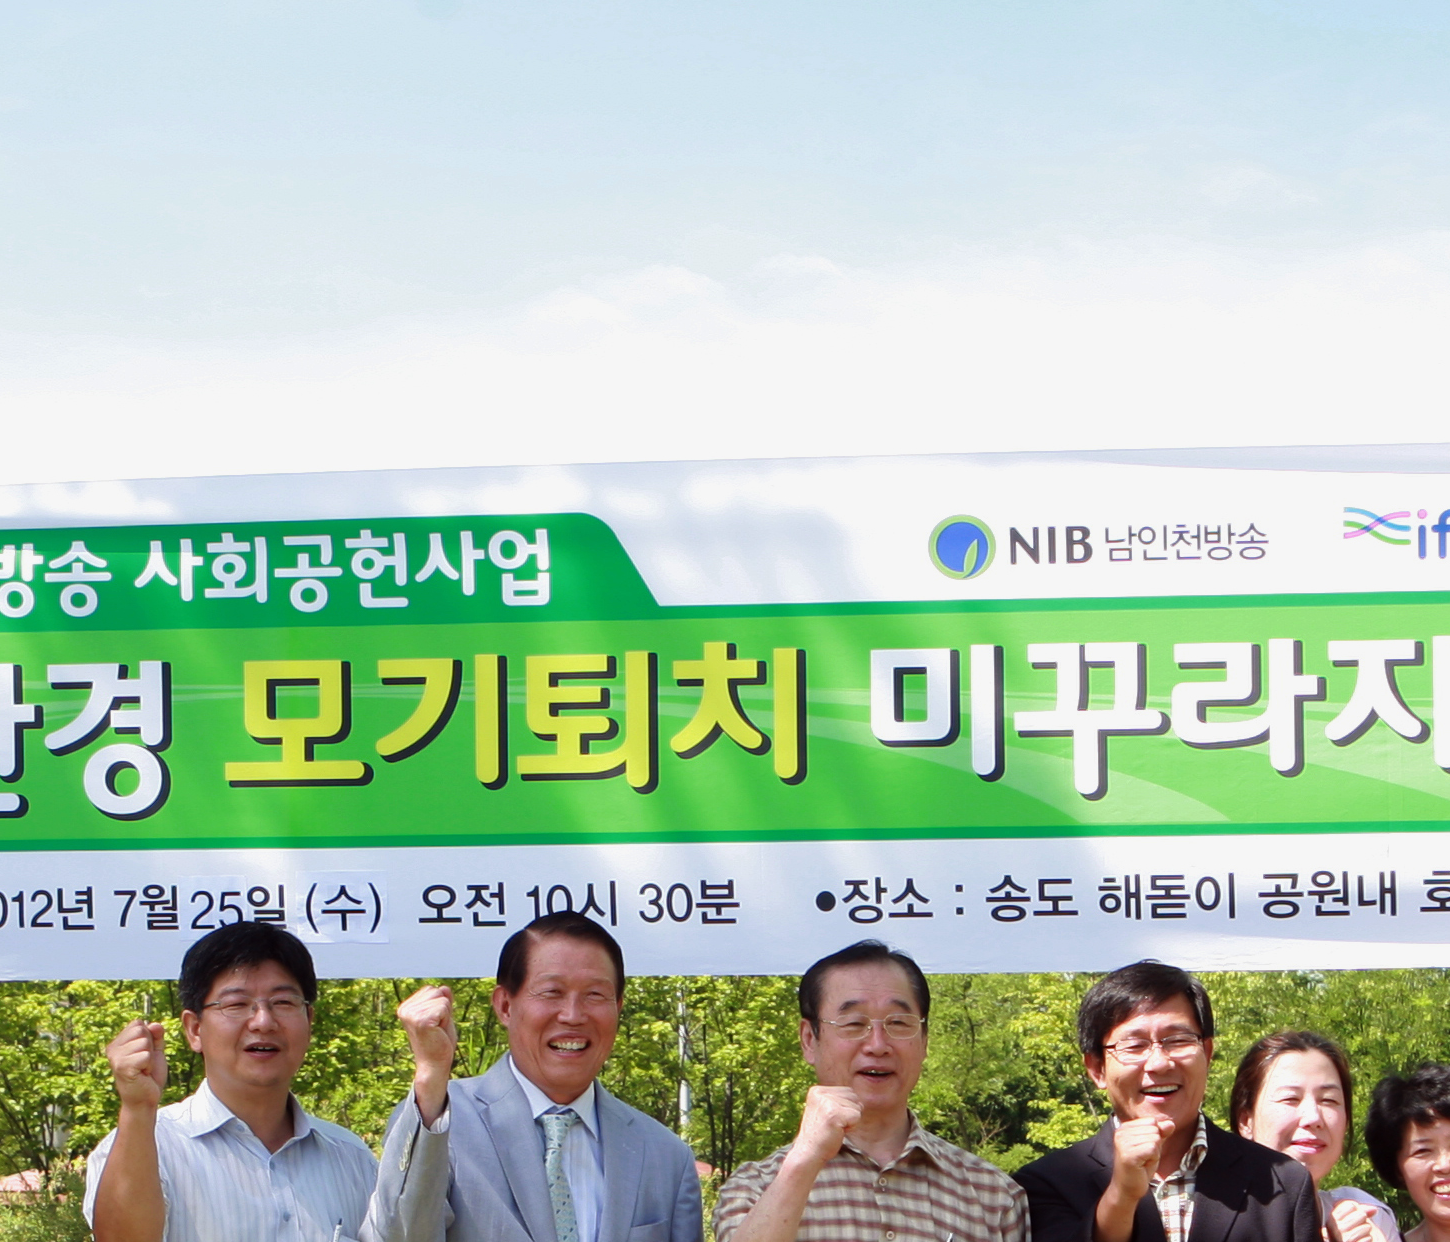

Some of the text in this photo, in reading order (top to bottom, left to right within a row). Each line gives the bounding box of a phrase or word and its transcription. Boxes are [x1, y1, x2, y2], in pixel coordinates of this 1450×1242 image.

[134, 528, 551, 613] 사회공헌사업
[1009, 523, 1270, 565] NIB 남인천방송
[225, 643, 809, 795] 모기퇴치
[305, 882, 383, 934] (수)
[417, 881, 507, 927] 오전
[525, 879, 619, 927] 10시
[638, 878, 741, 926] 30분
[842, 876, 935, 924] 장소
[985, 874, 1080, 923] 송도
[1097, 871, 1238, 921] 해돋이
[1257, 869, 1398, 919] 공원내
